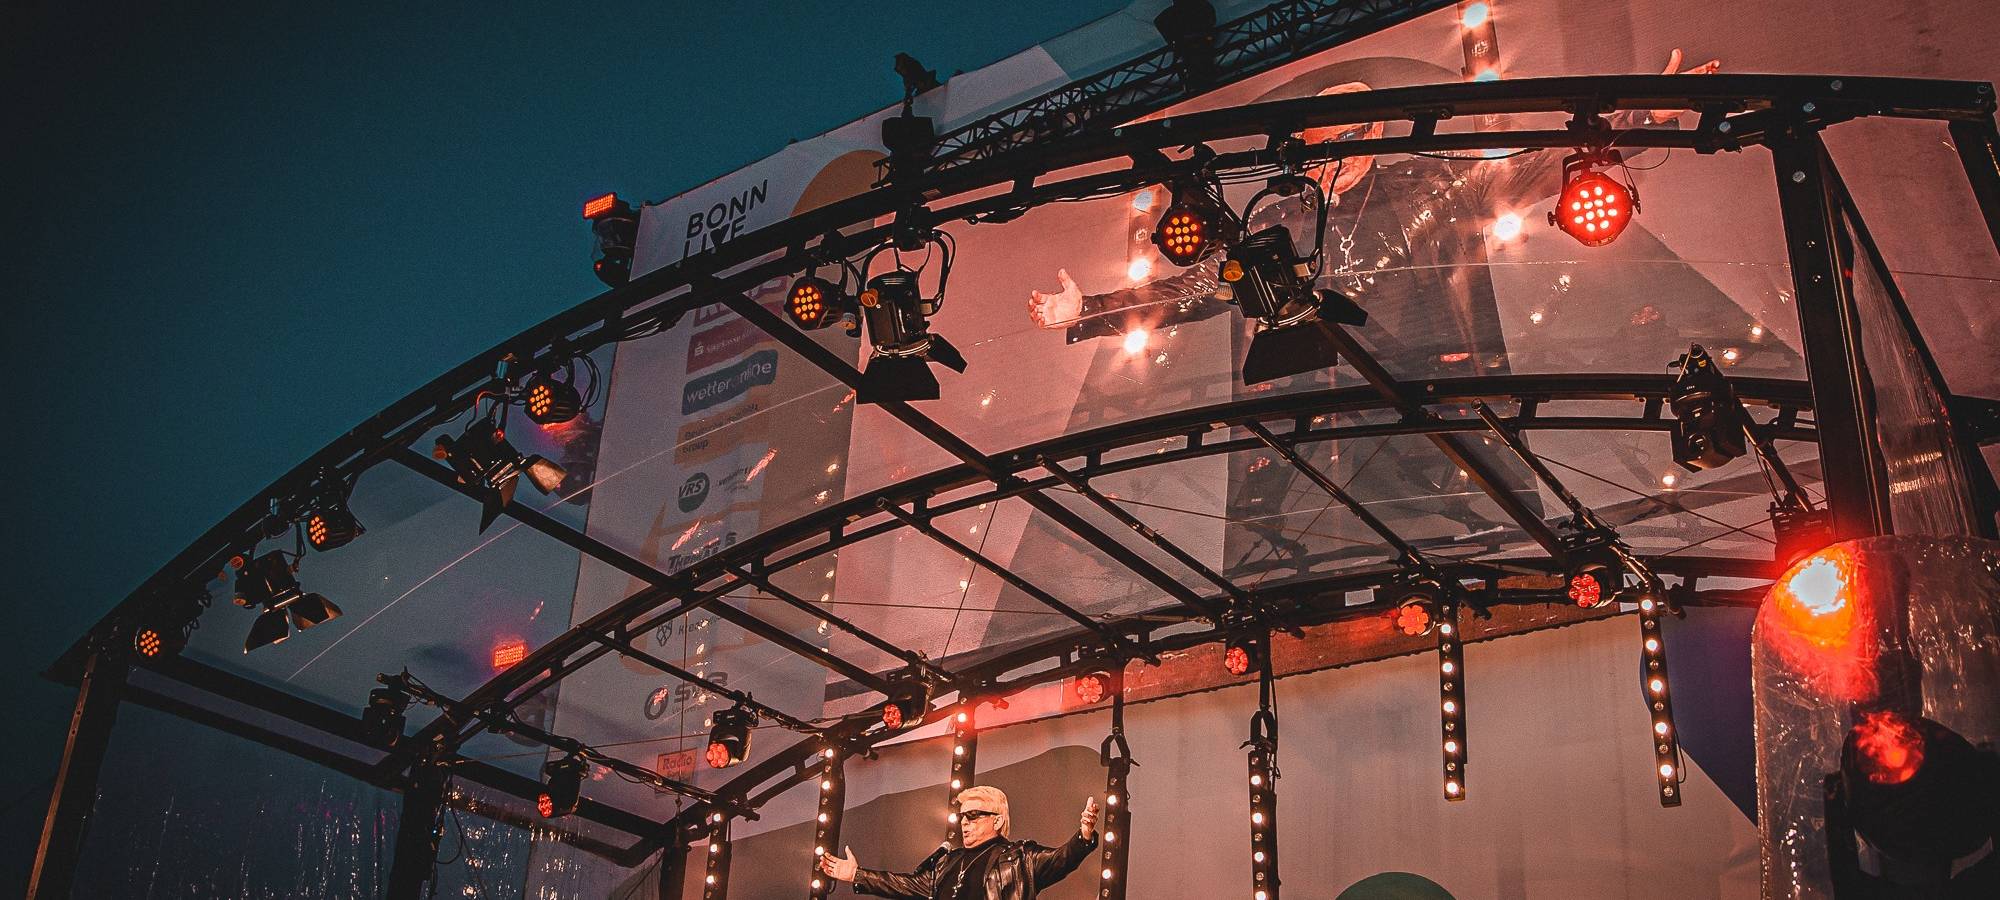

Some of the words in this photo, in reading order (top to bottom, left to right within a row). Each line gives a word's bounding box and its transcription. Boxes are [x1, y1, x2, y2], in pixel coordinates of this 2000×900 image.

[686, 179, 767, 239] BONN
[687, 361, 772, 402] wetternline
[680, 480, 703, 497] VRS
